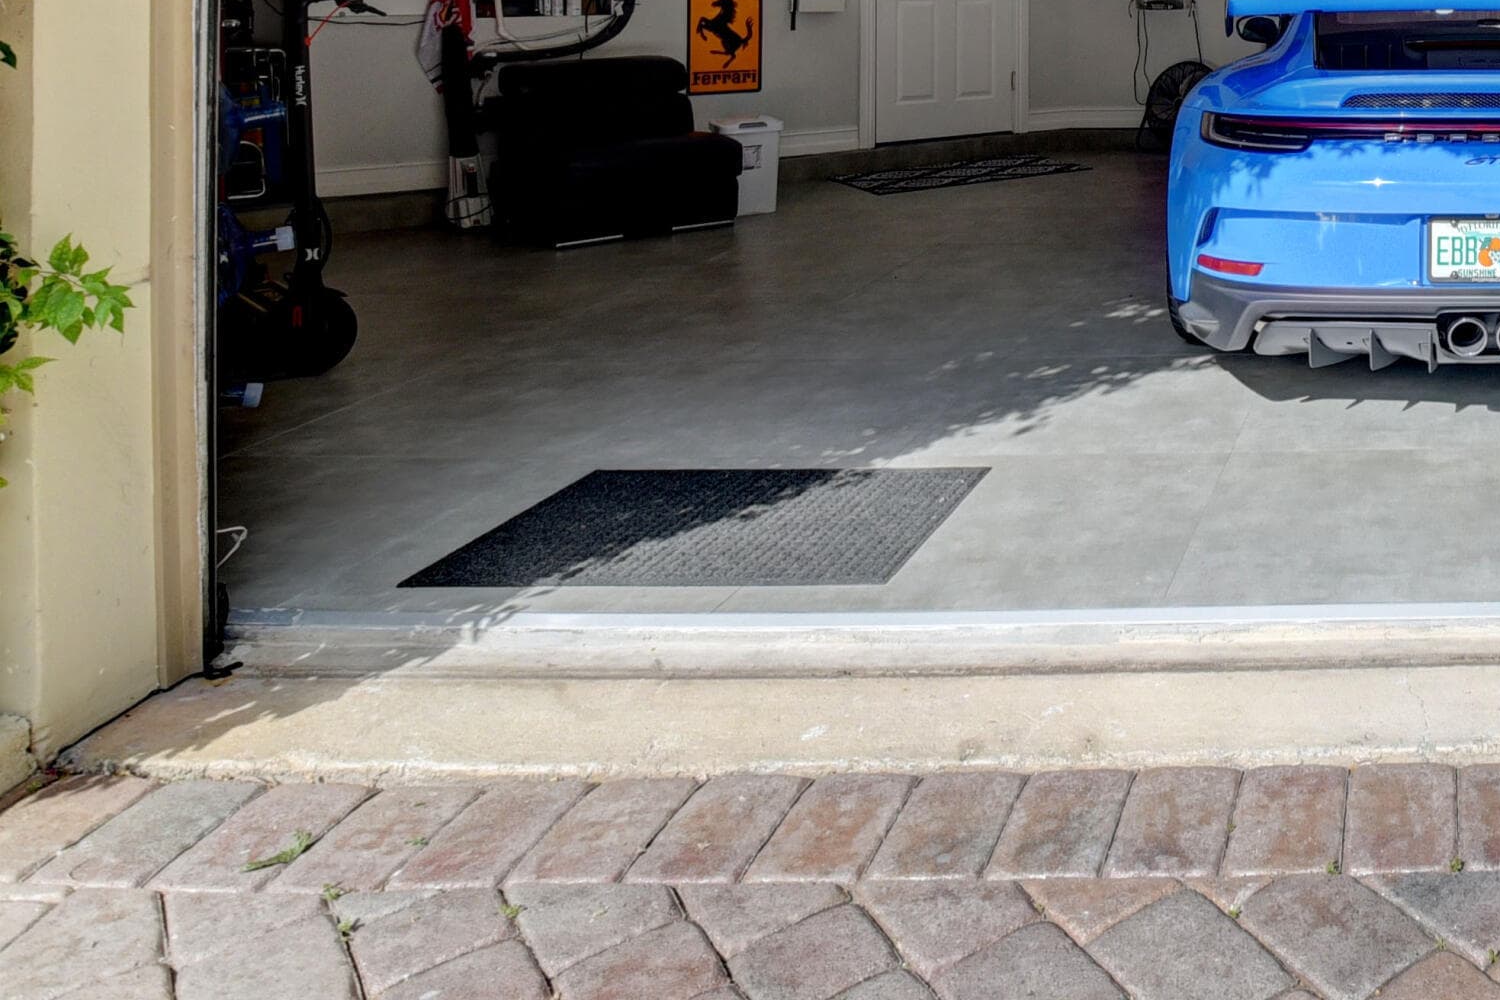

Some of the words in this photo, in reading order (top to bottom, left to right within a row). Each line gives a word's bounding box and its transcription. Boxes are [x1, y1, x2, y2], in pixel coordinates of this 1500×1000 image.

[294, 65, 306, 96] Hurley
[691, 69, 757, 86] Ferrari
[1437, 236, 1477, 265] EBB
[1457, 269, 1497, 279] SUNSHINE
